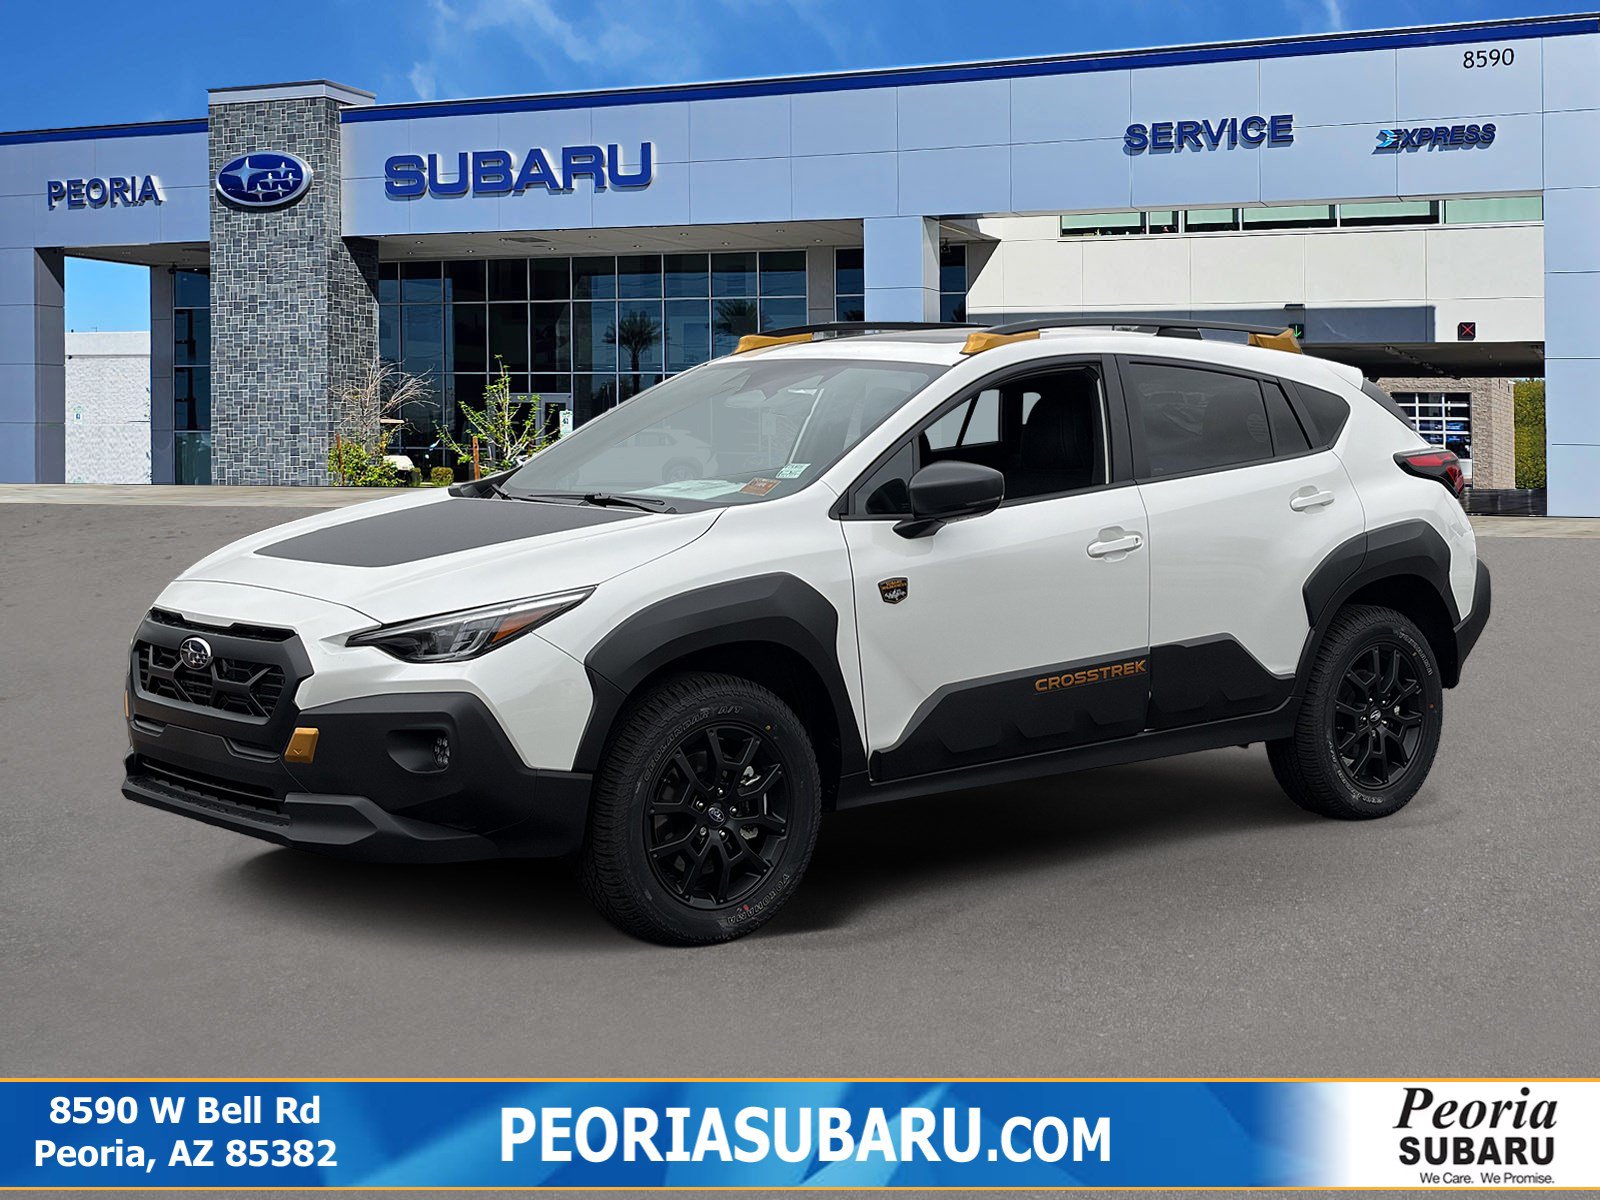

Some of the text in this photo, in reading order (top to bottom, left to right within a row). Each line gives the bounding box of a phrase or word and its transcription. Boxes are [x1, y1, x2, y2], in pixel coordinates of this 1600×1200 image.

[1463, 48, 1514, 68] 8590
[1125, 115, 1294, 151] SERVICE
[1375, 123, 1497, 149] EXPRESS
[385, 142, 652, 196] SUBARU
[47, 175, 162, 208] PEORIA
[1034, 660, 1147, 692] CROSSTREK
